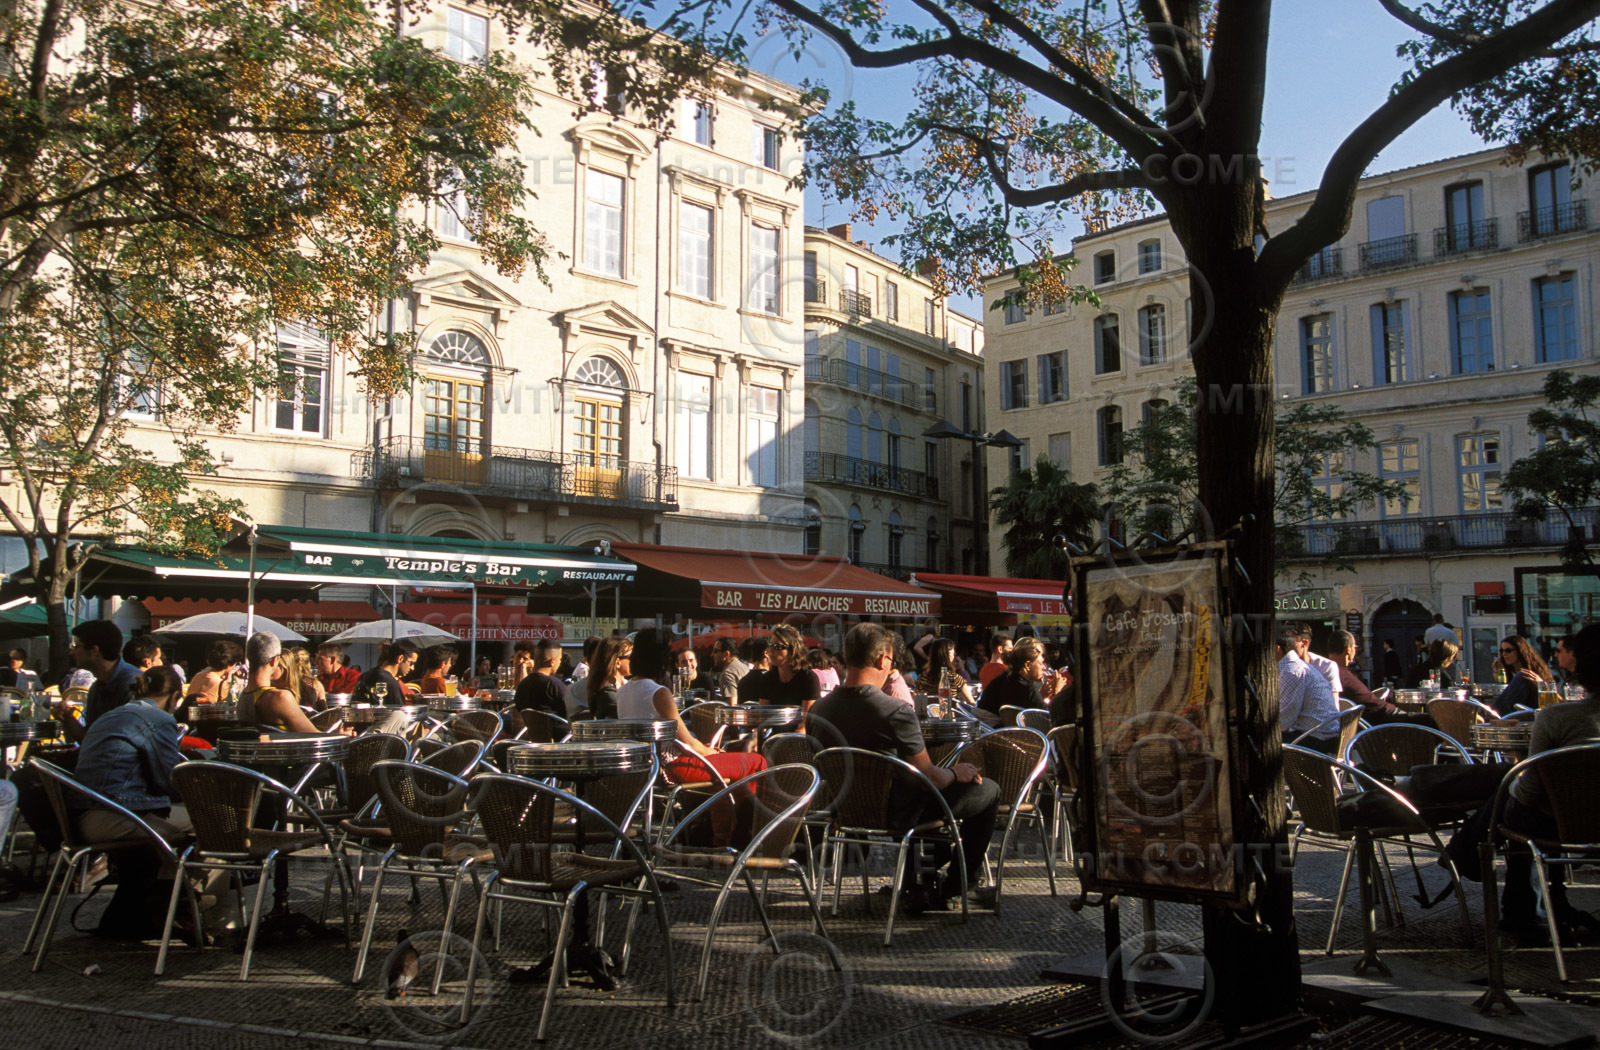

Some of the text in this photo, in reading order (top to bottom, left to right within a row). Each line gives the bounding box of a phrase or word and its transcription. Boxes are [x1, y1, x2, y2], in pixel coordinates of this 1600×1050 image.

[305, 554, 333, 567] BAR
[384, 556, 522, 576] Temple's Bar
[563, 570, 627, 582] RESTAURANT
[717, 590, 930, 615] BAR "LES PLANCHES" RESTAURANT
[1040, 600, 1053, 613] LE
[1142, 606, 1192, 631] Joseph
[286, 621, 350, 633] RESTAURANT
[501, 628, 558, 640] NEGRESCO
